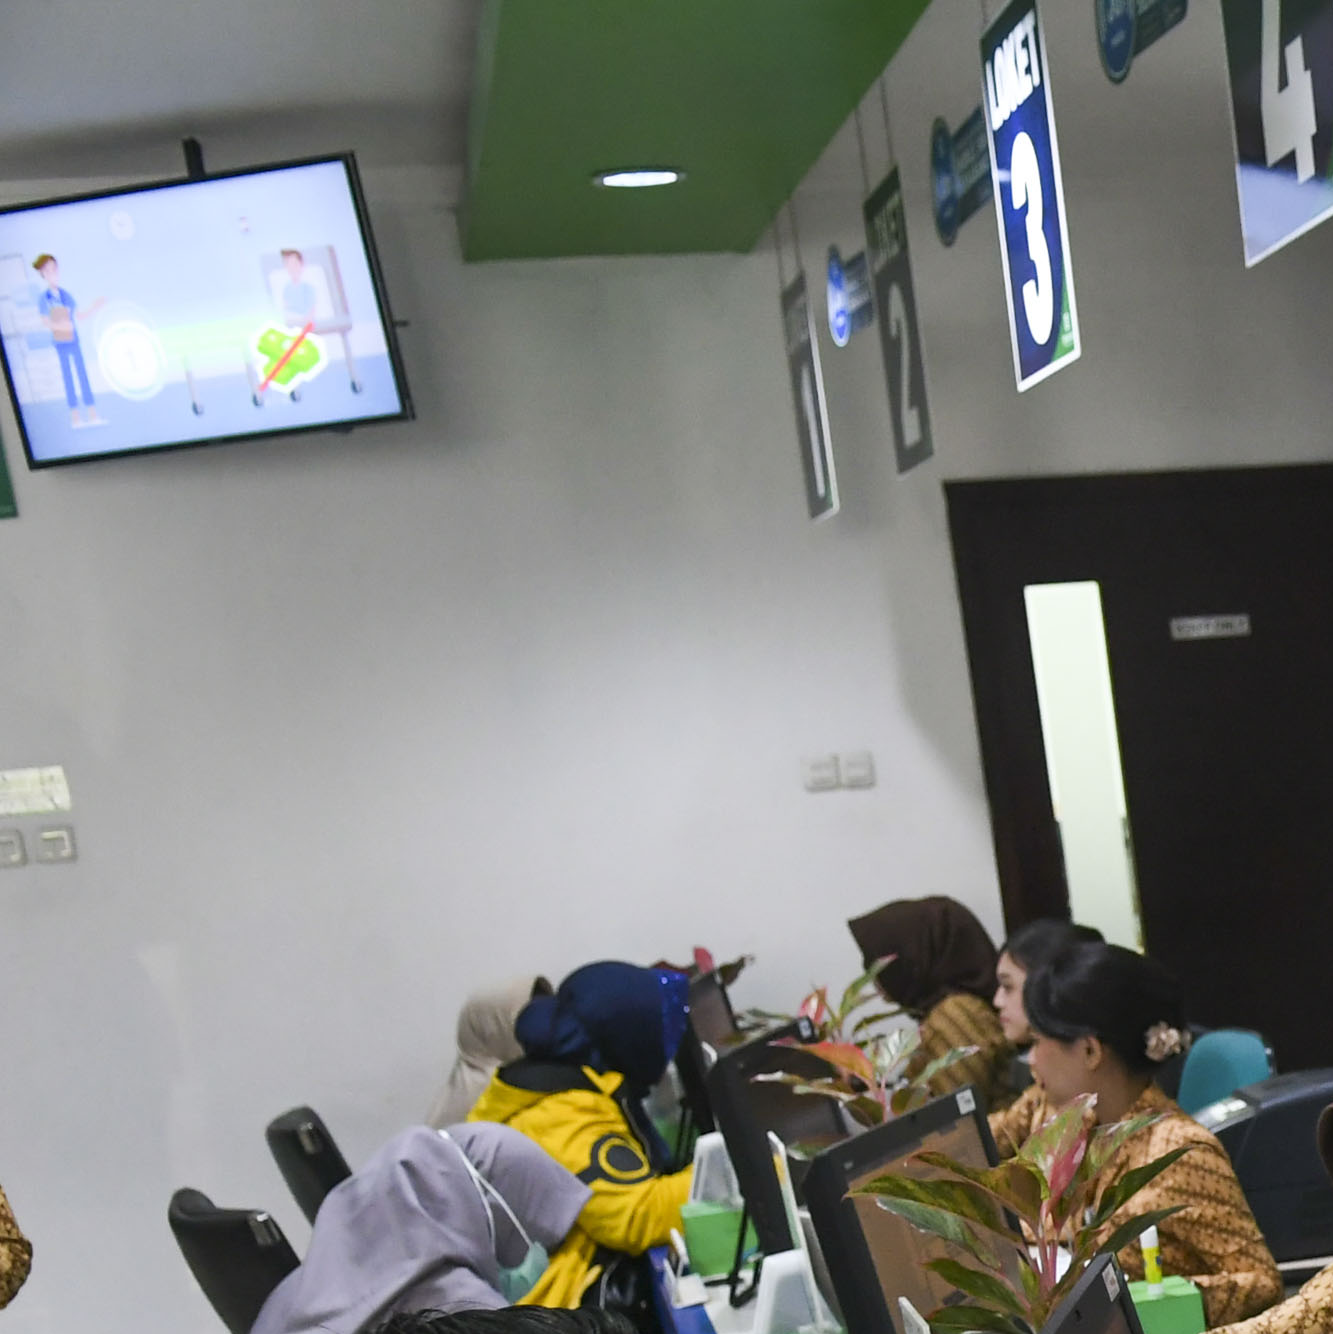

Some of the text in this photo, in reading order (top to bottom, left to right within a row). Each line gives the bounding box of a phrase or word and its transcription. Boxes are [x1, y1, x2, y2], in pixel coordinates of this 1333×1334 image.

[986, 9, 1040, 131] LOKET
[1261, 0, 1317, 185] 4
[1011, 131, 1054, 346] 3
[801, 365, 826, 500] 1
[888, 282, 922, 451] 2
